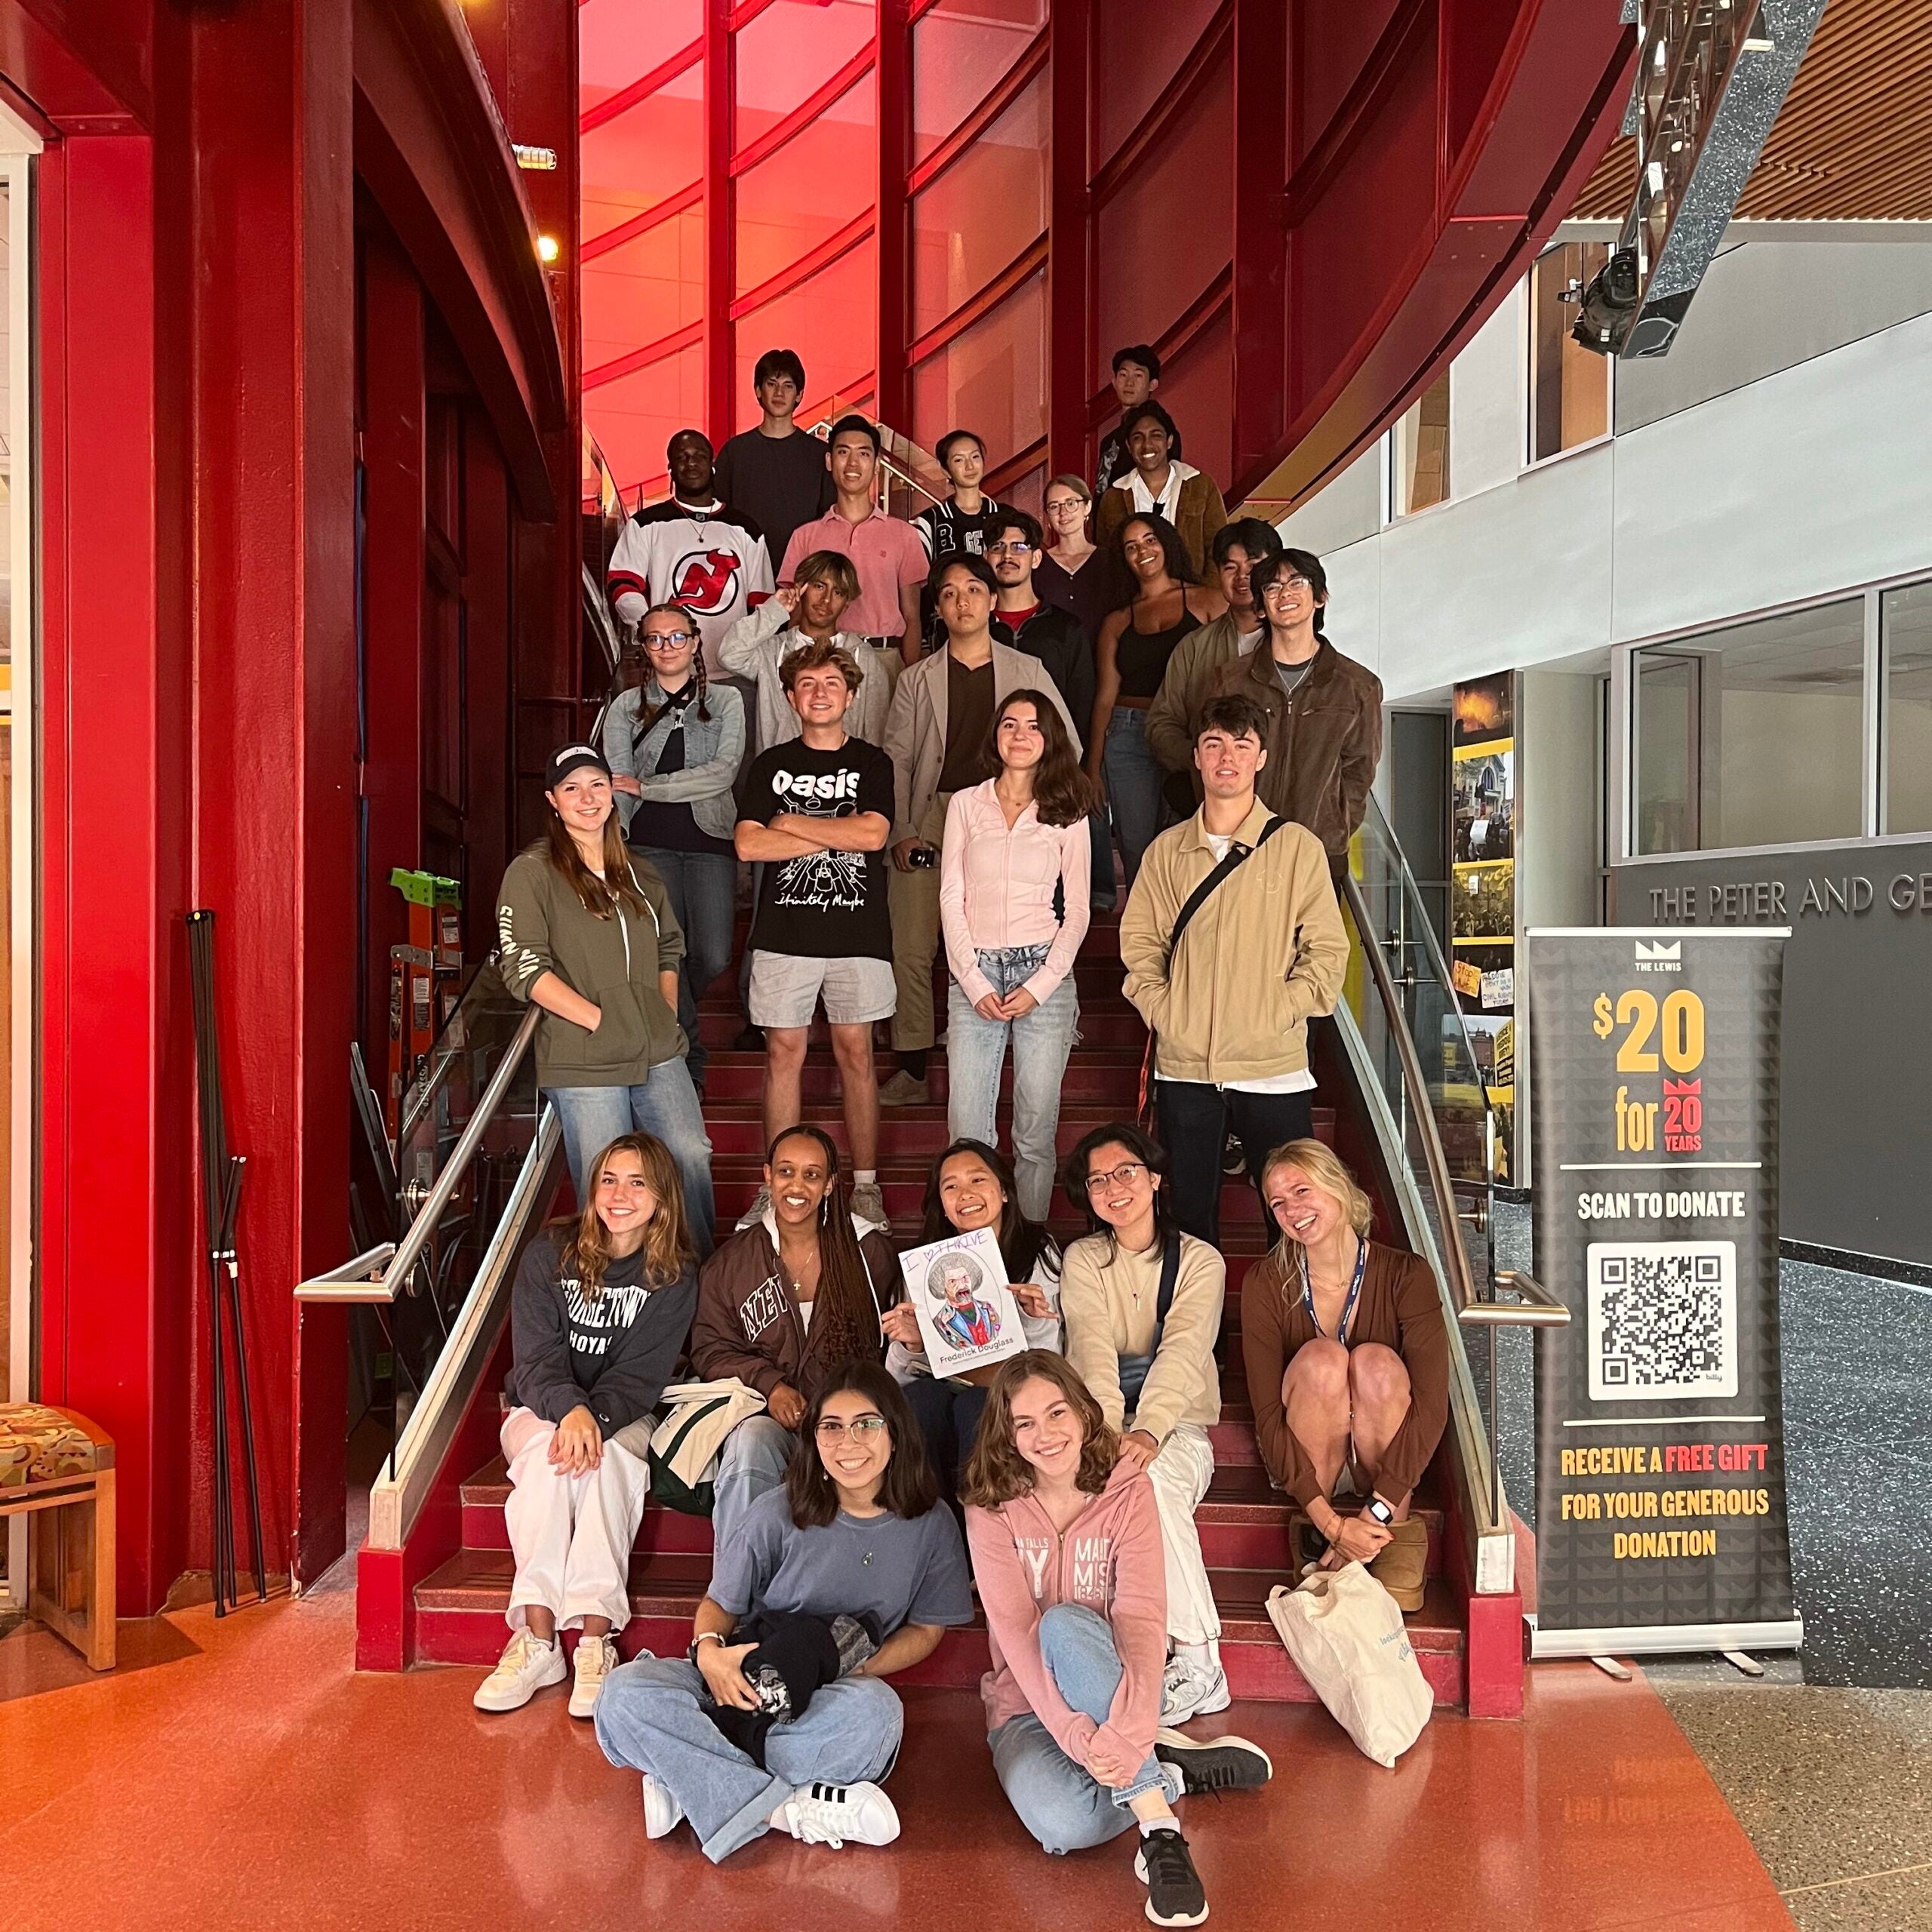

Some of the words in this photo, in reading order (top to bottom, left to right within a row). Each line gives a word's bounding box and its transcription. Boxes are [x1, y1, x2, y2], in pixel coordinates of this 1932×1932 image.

[772, 768, 860, 798] Oasis
[1650, 888, 1696, 920] THE
[1709, 882, 1786, 918] PETER
[1800, 875, 1874, 915] AND
[1887, 873, 1932, 911] GE
[1635, 962, 1653, 972] THE
[1654, 962, 1682, 972] LEWIS
[1592, 989, 1705, 1073] $20
[1616, 1086, 1660, 1152] for
[1664, 1097, 1702, 1134] 20
[1664, 1136, 1702, 1152] YEARS
[1578, 1193, 1629, 1220] SCAN
[1634, 1192, 1664, 1219] TO
[1666, 1191, 1746, 1218] DONATE
[903, 1253, 918, 1272] I
[940, 1348, 977, 1364] Frederick
[977, 1337, 1014, 1352] Douglass
[1561, 1447, 1647, 1476] RECEIVE
[1649, 1447, 1663, 1472] A
[1666, 1445, 1715, 1472] FREE
[1718, 1444, 1768, 1470] GIFT
[1561, 1494, 1601, 1520] FOR
[1604, 1492, 1658, 1518] YOUR
[1661, 1489, 1769, 1517] GENEROUS
[1026, 1537, 1048, 1549] FALLS
[1614, 1530, 1716, 1558] DONATION
